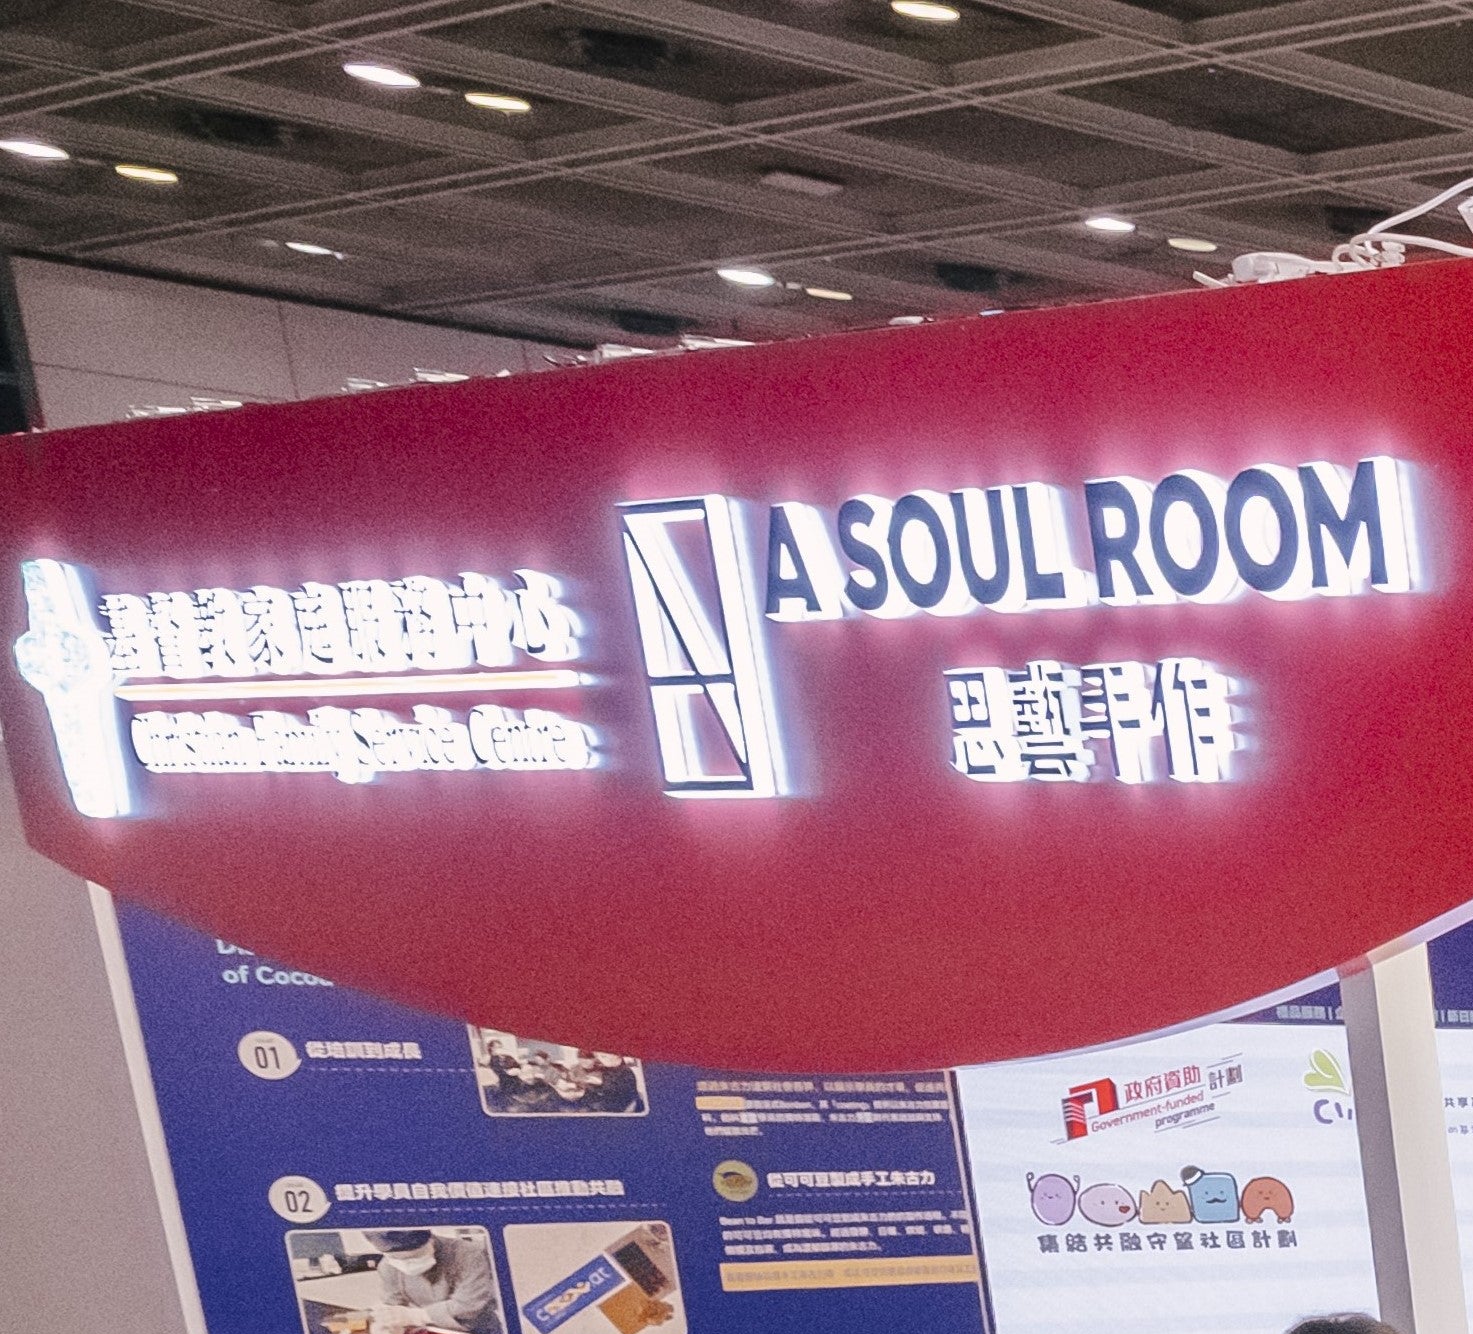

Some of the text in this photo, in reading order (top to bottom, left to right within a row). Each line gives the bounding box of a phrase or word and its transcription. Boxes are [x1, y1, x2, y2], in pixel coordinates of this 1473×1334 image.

[766, 457, 1402, 621] A SOUL ROOM
[222, 965, 250, 985] of
[254, 1045, 281, 1071] 01
[1124, 1064, 1243, 1104] 政府資助 計劃
[1091, 1091, 1204, 1133] Government-funded
[1155, 1101, 1216, 1129] programme
[285, 1190, 313, 1214] 02
